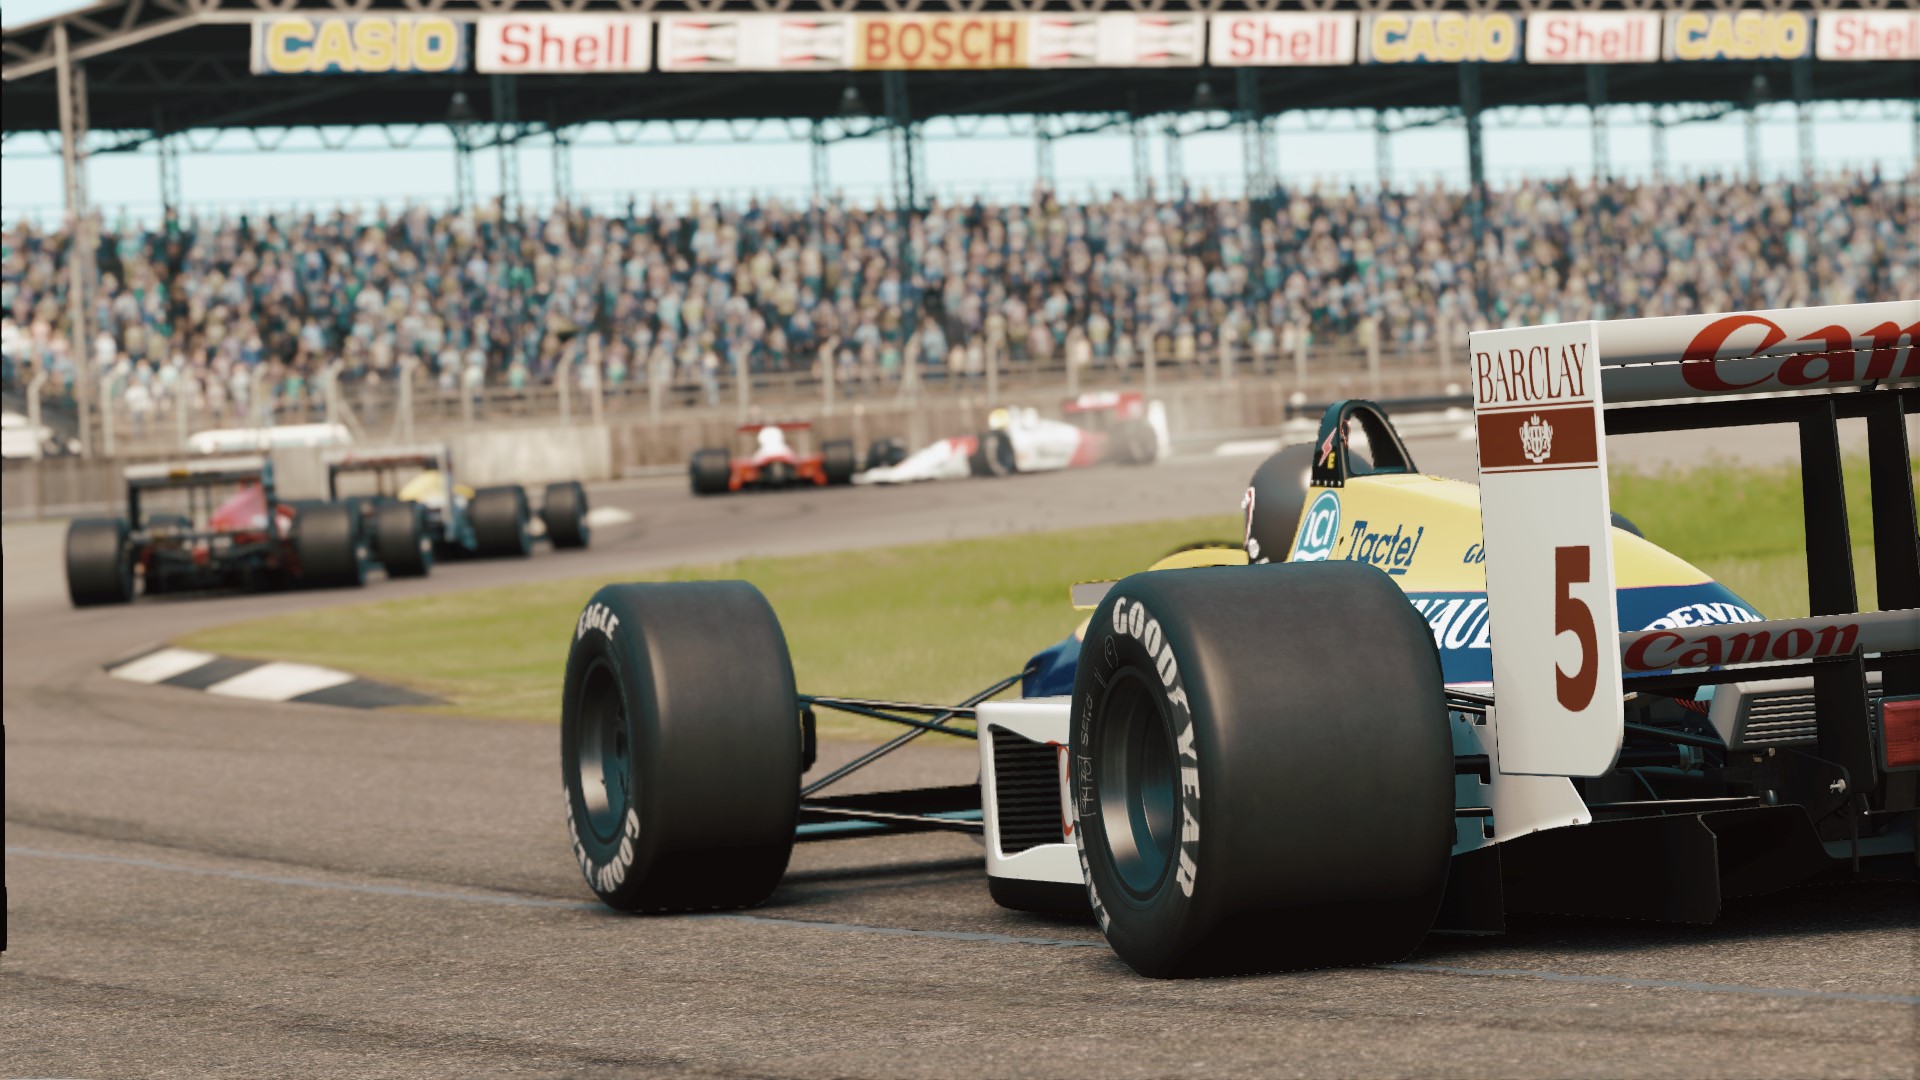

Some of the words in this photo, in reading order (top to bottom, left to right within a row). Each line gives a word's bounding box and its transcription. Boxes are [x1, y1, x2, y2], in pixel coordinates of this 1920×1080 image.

[267, 17, 459, 73] CASIO
[500, 22, 631, 66] Shell
[865, 20, 1017, 63] BOSCH
[1230, 19, 1338, 61] Shell
[1371, 14, 1517, 62] CASIO
[1545, 18, 1645, 59] Shell
[1675, 12, 1809, 59] CASIO
[1476, 343, 1587, 403] BARCLAY
[1303, 509, 1337, 548] ICI
[1345, 520, 1424, 567] Tactel
[577, 602, 620, 641] EAGLE
[1555, 545, 1599, 712] 5
[1624, 623, 1860, 672] Canon
[1113, 597, 1200, 898] GOODYEAR
